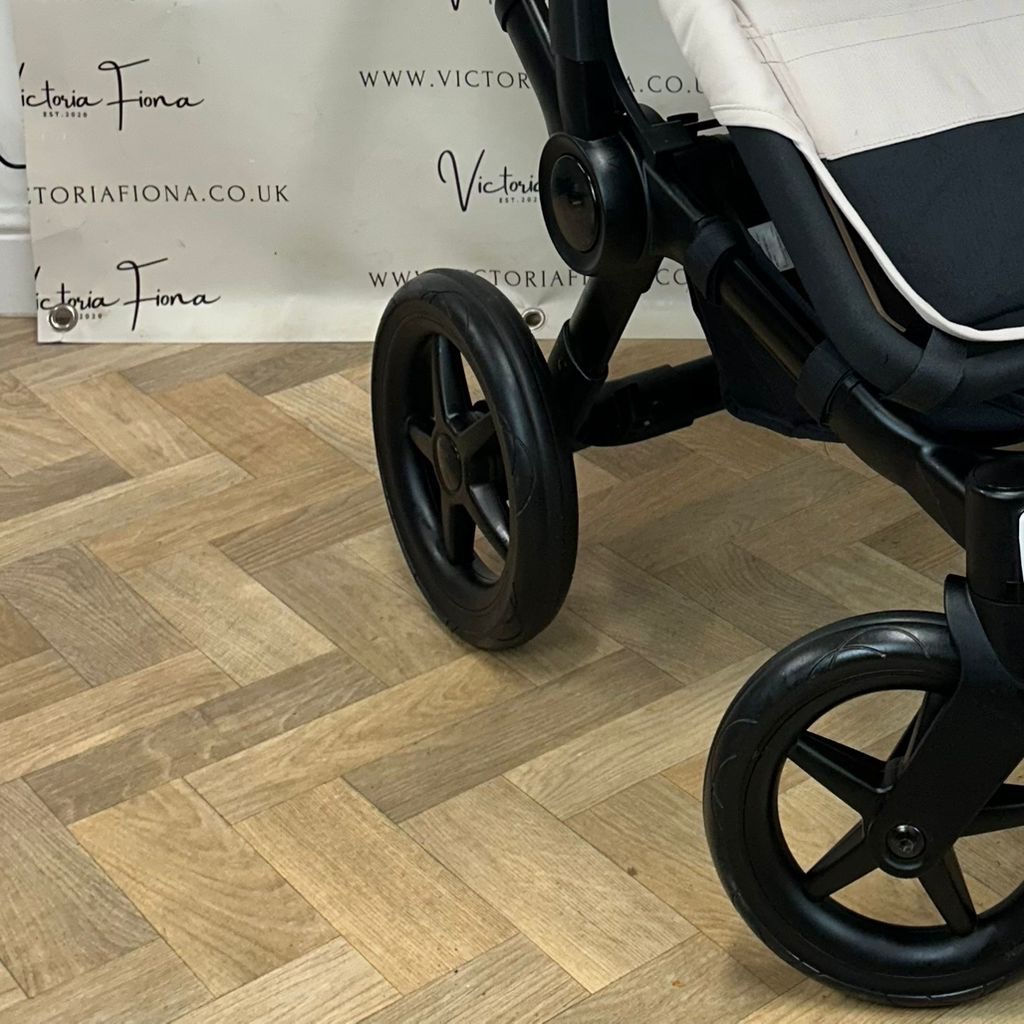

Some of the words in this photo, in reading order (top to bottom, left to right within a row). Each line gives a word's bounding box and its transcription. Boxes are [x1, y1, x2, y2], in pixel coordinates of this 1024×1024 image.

[98, 58, 205, 131] Fiona
[27, 185, 290, 205] TORIAFIONA.CO.UK
[116, 257, 221, 331] Fiona
